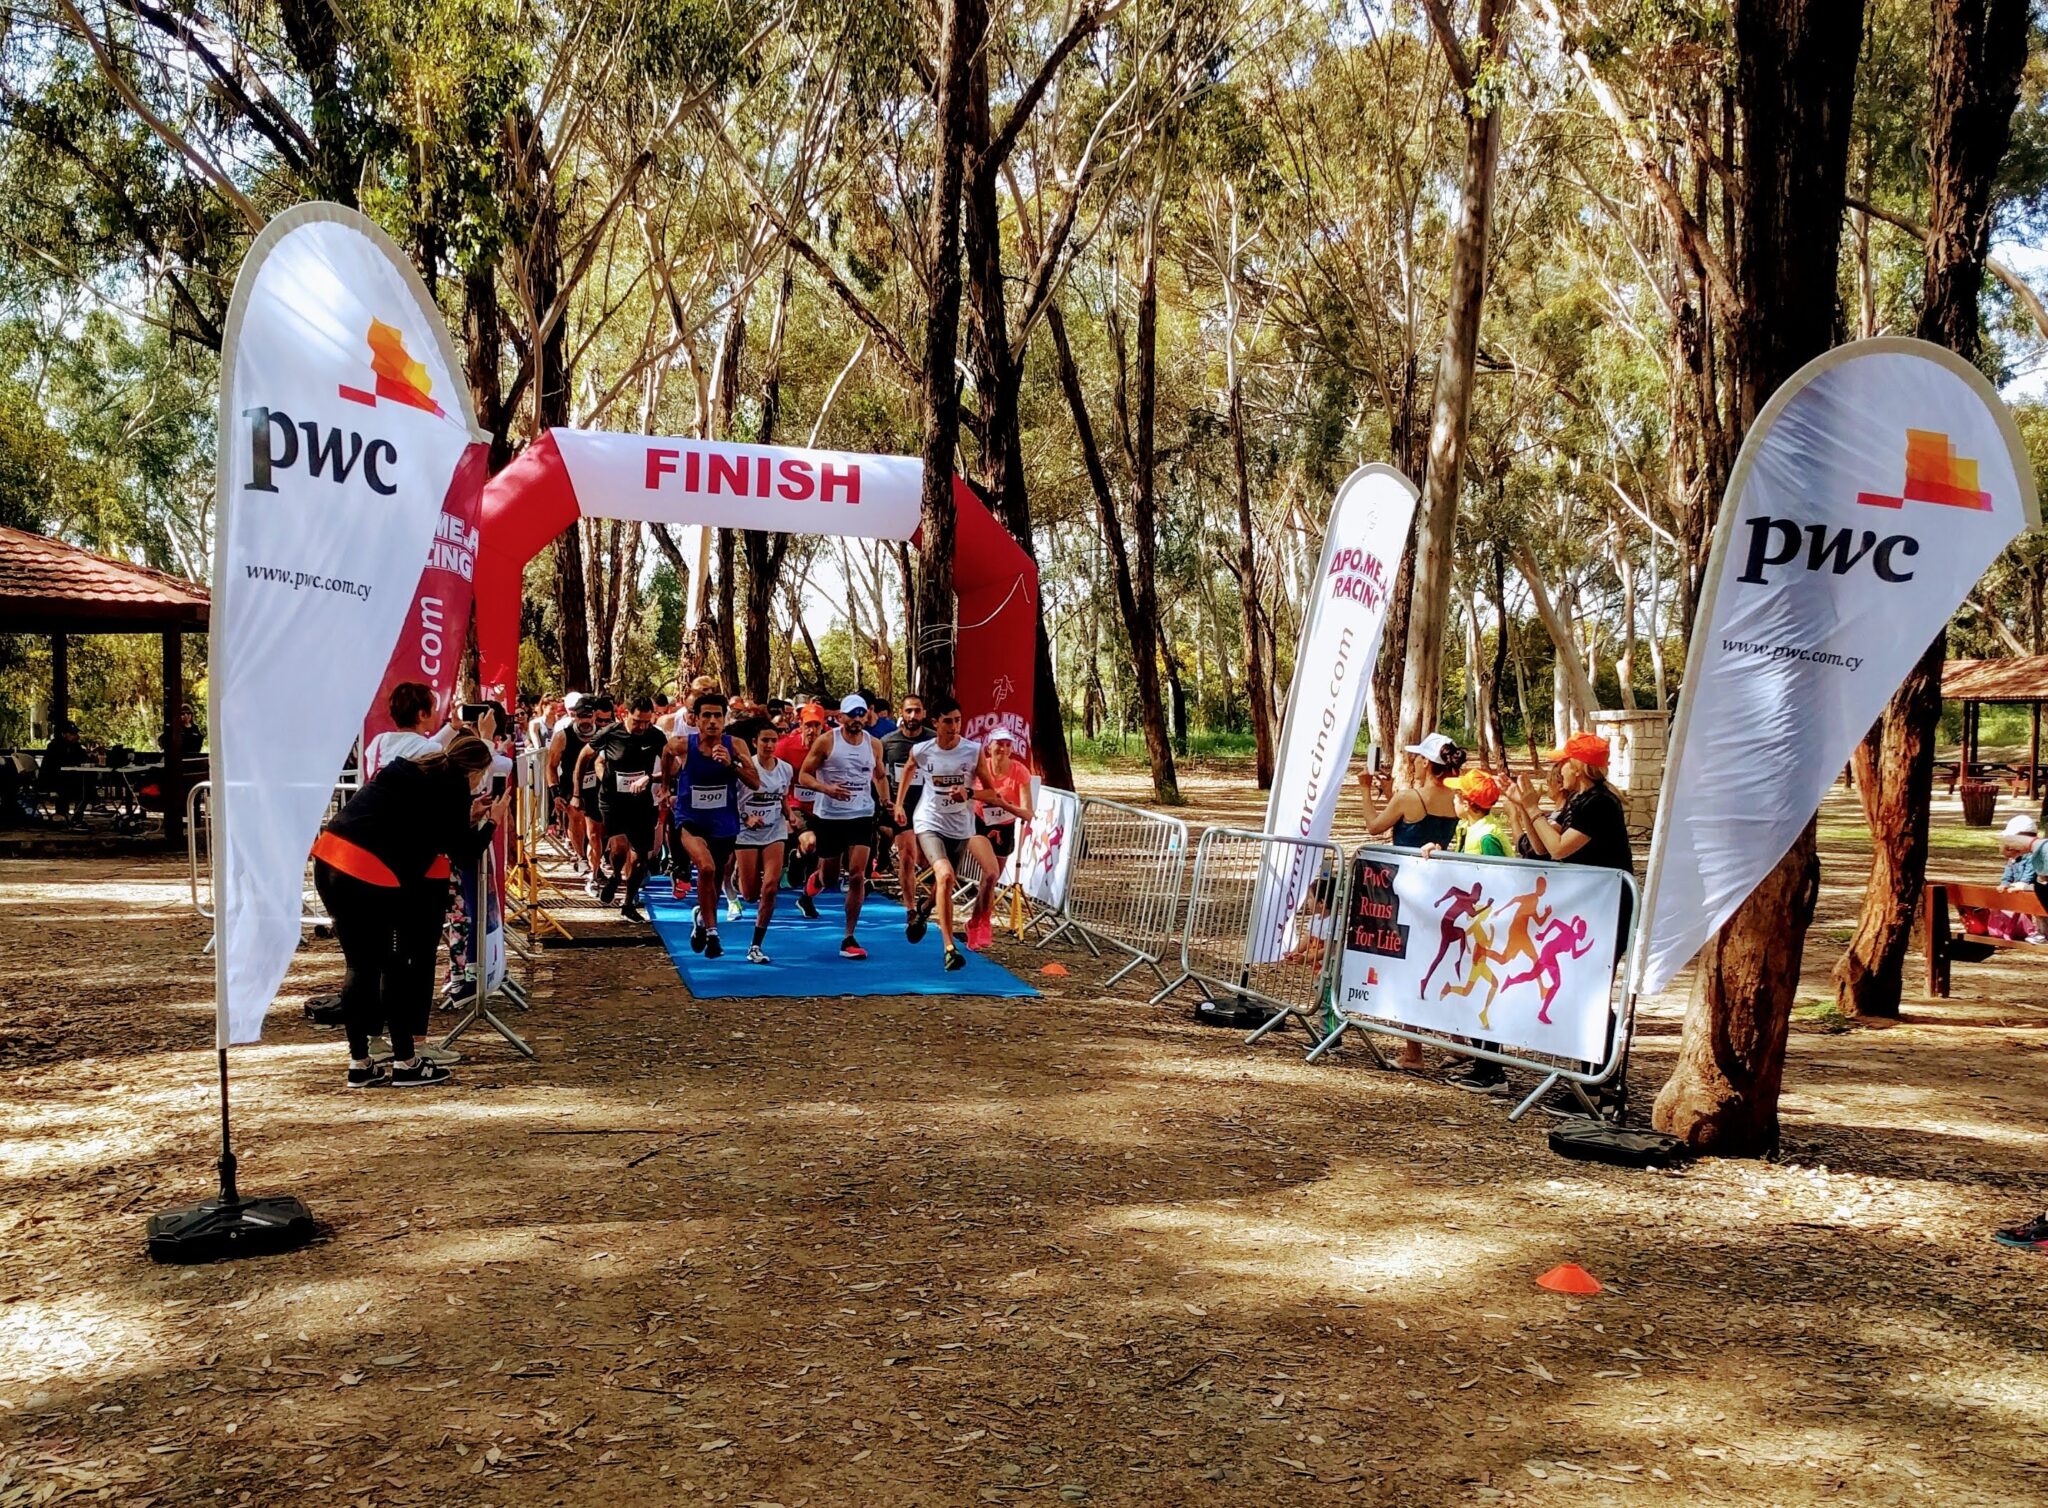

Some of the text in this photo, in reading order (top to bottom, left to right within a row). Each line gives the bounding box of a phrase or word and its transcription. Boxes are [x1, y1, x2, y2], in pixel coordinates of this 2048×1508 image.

[242, 406, 398, 495] pwc
[645, 447, 860, 504] FINISH
[1736, 516, 1919, 585] pwc
[245, 564, 372, 601] www.pwc.com.cy
[1722, 639, 1863, 672] www.pwc.com.cy
[699, 793, 722, 802] 290
[1363, 866, 1391, 889] PwC
[1359, 896, 1393, 920] Runs
[1355, 925, 1402, 952] for Life
[1347, 986, 1370, 1002] pwc
